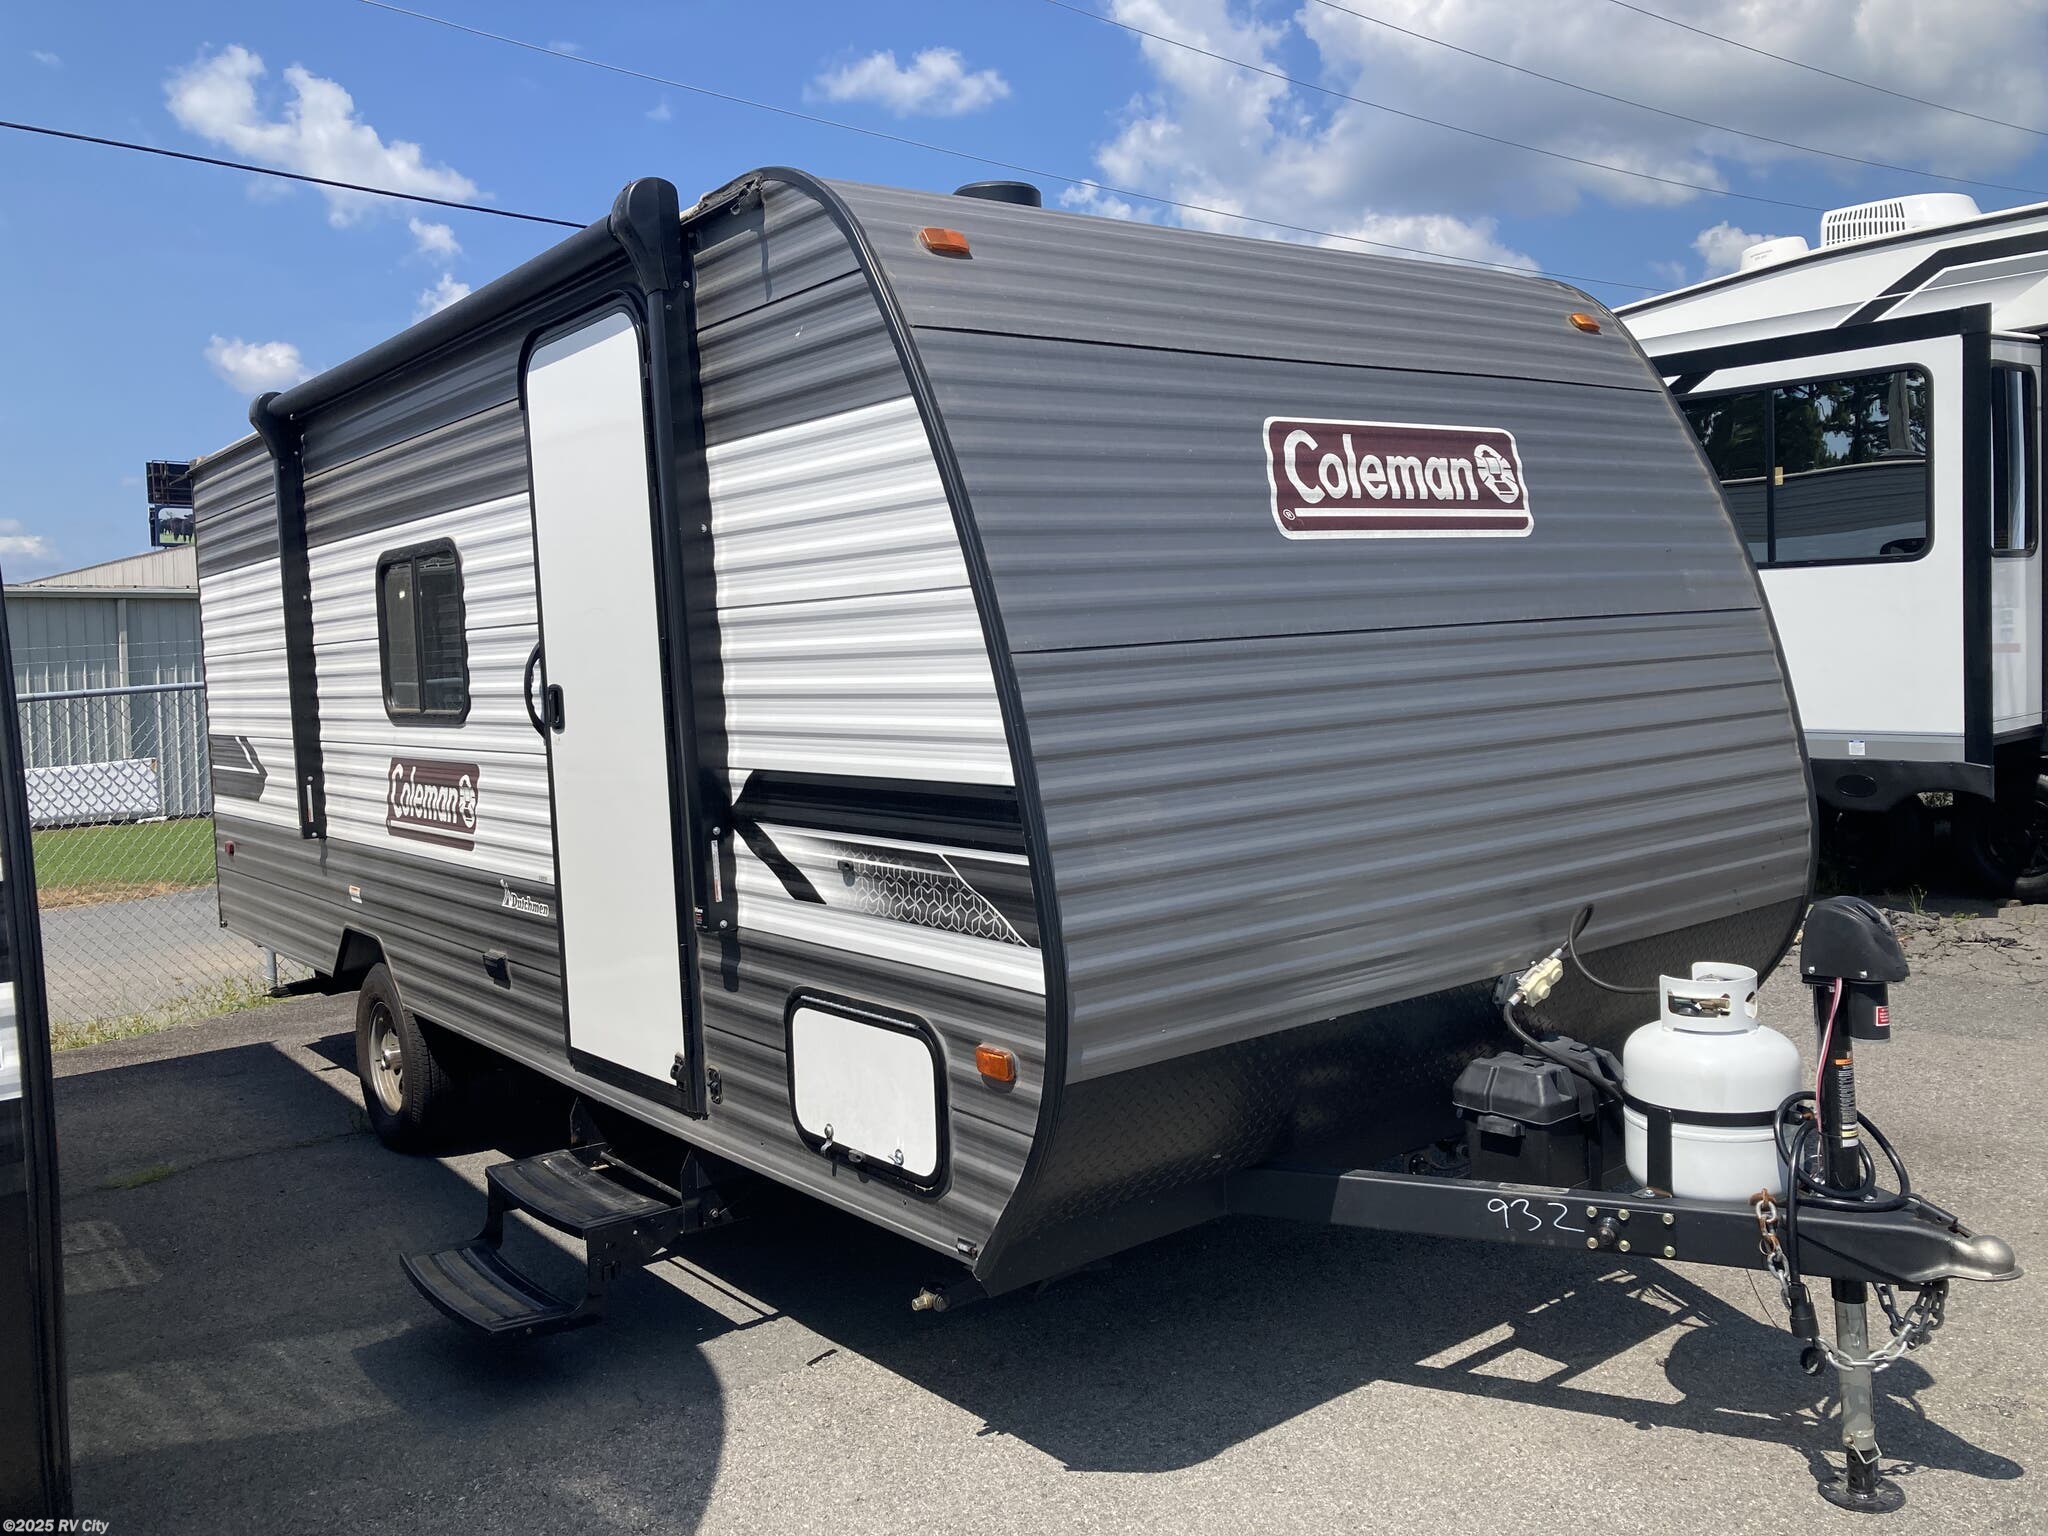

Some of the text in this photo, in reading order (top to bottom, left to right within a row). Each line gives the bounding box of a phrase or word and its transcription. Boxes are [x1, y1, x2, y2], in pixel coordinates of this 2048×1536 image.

[1284, 429, 1479, 504] Coleman
[391, 763, 458, 824] Coleman
[511, 891, 549, 917] Dutchmen
[1487, 1198, 1585, 1232] 932
